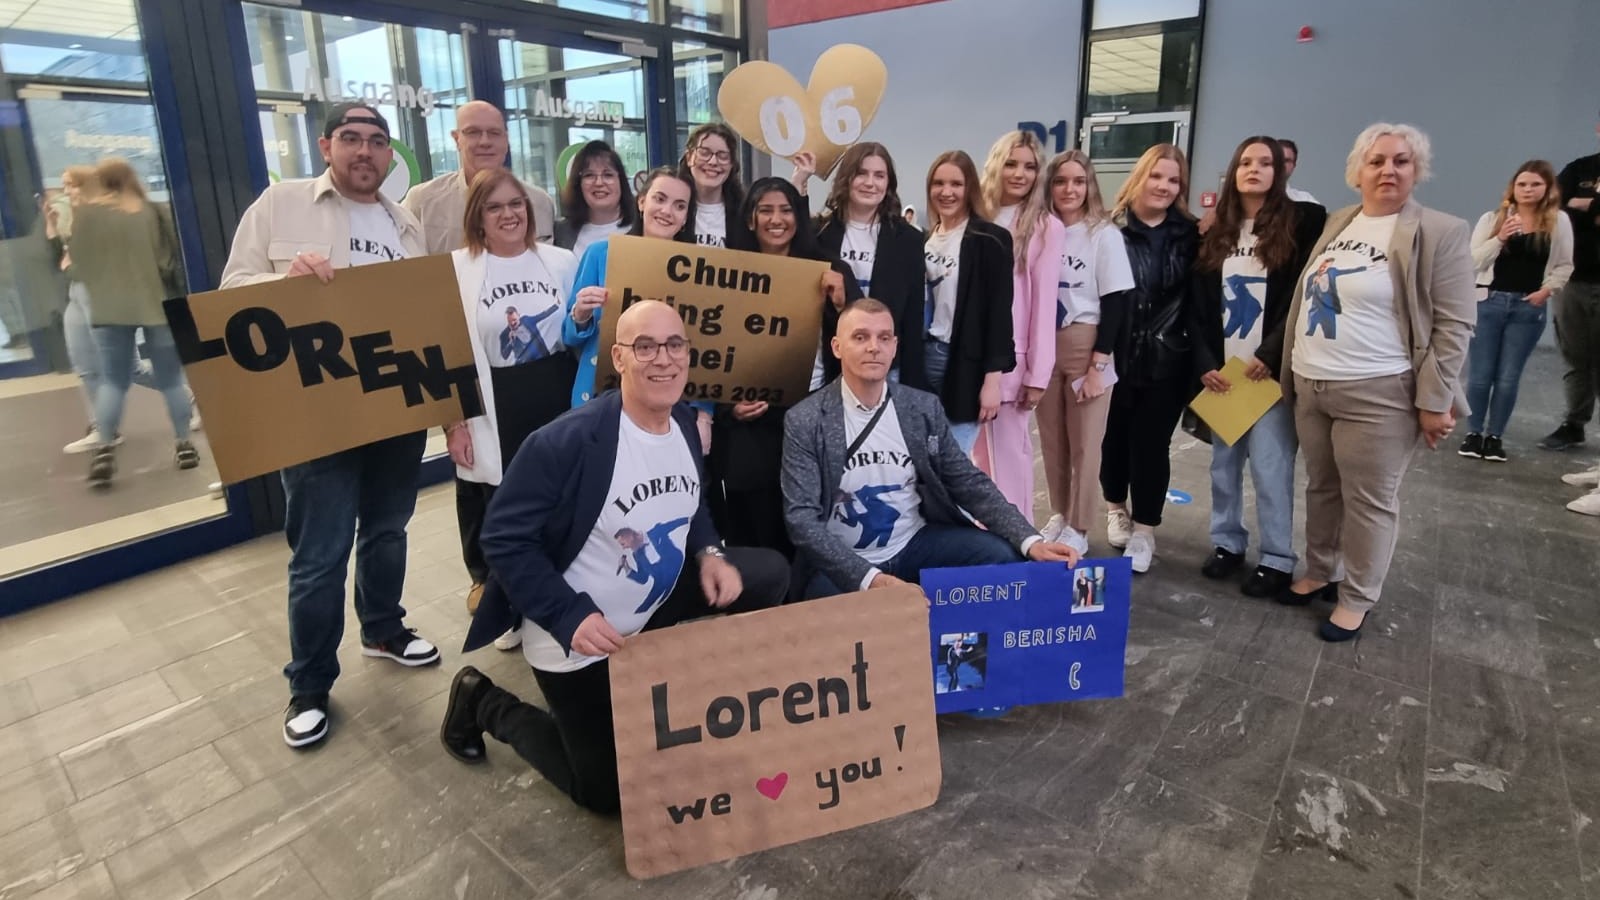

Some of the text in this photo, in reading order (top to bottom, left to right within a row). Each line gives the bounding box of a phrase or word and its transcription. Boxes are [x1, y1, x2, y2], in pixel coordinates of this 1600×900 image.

[535, 89, 624, 129] Ausgang
[666, 254, 771, 295] Chum
[744, 313, 789, 337] en
[163, 297, 486, 420] LORENT
[684, 382, 723, 399] 013
[612, 474, 700, 517] LORENT
[935, 581, 1027, 606] LORENT
[1003, 624, 1097, 649] BERISHA
[651, 641, 872, 751] Lorent
[667, 791, 732, 825] we
